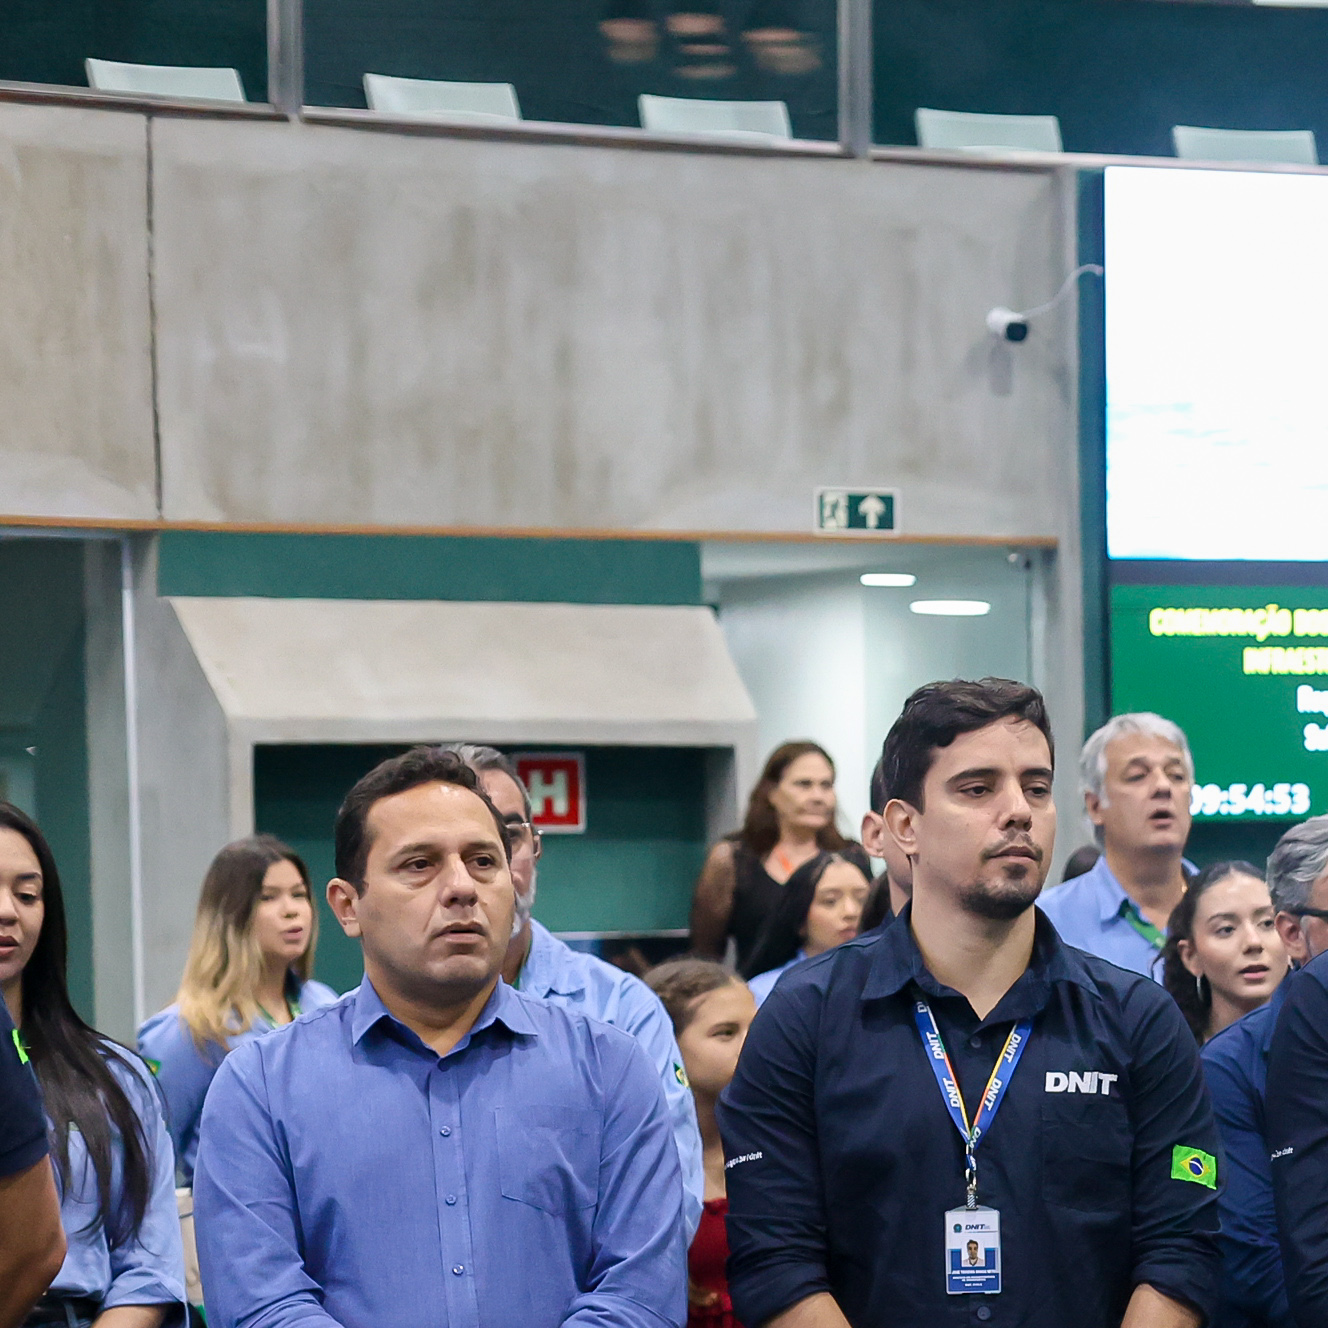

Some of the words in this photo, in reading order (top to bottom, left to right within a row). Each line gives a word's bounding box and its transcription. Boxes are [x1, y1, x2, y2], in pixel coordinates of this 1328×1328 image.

[529, 769, 568, 815] H
[926, 1031, 945, 1060] DNIT
[1004, 1033, 1022, 1063] DNIT
[943, 1077, 960, 1108] DNIT
[984, 1079, 1002, 1111] DNIT
[1045, 1071, 1118, 1096] DNIT
